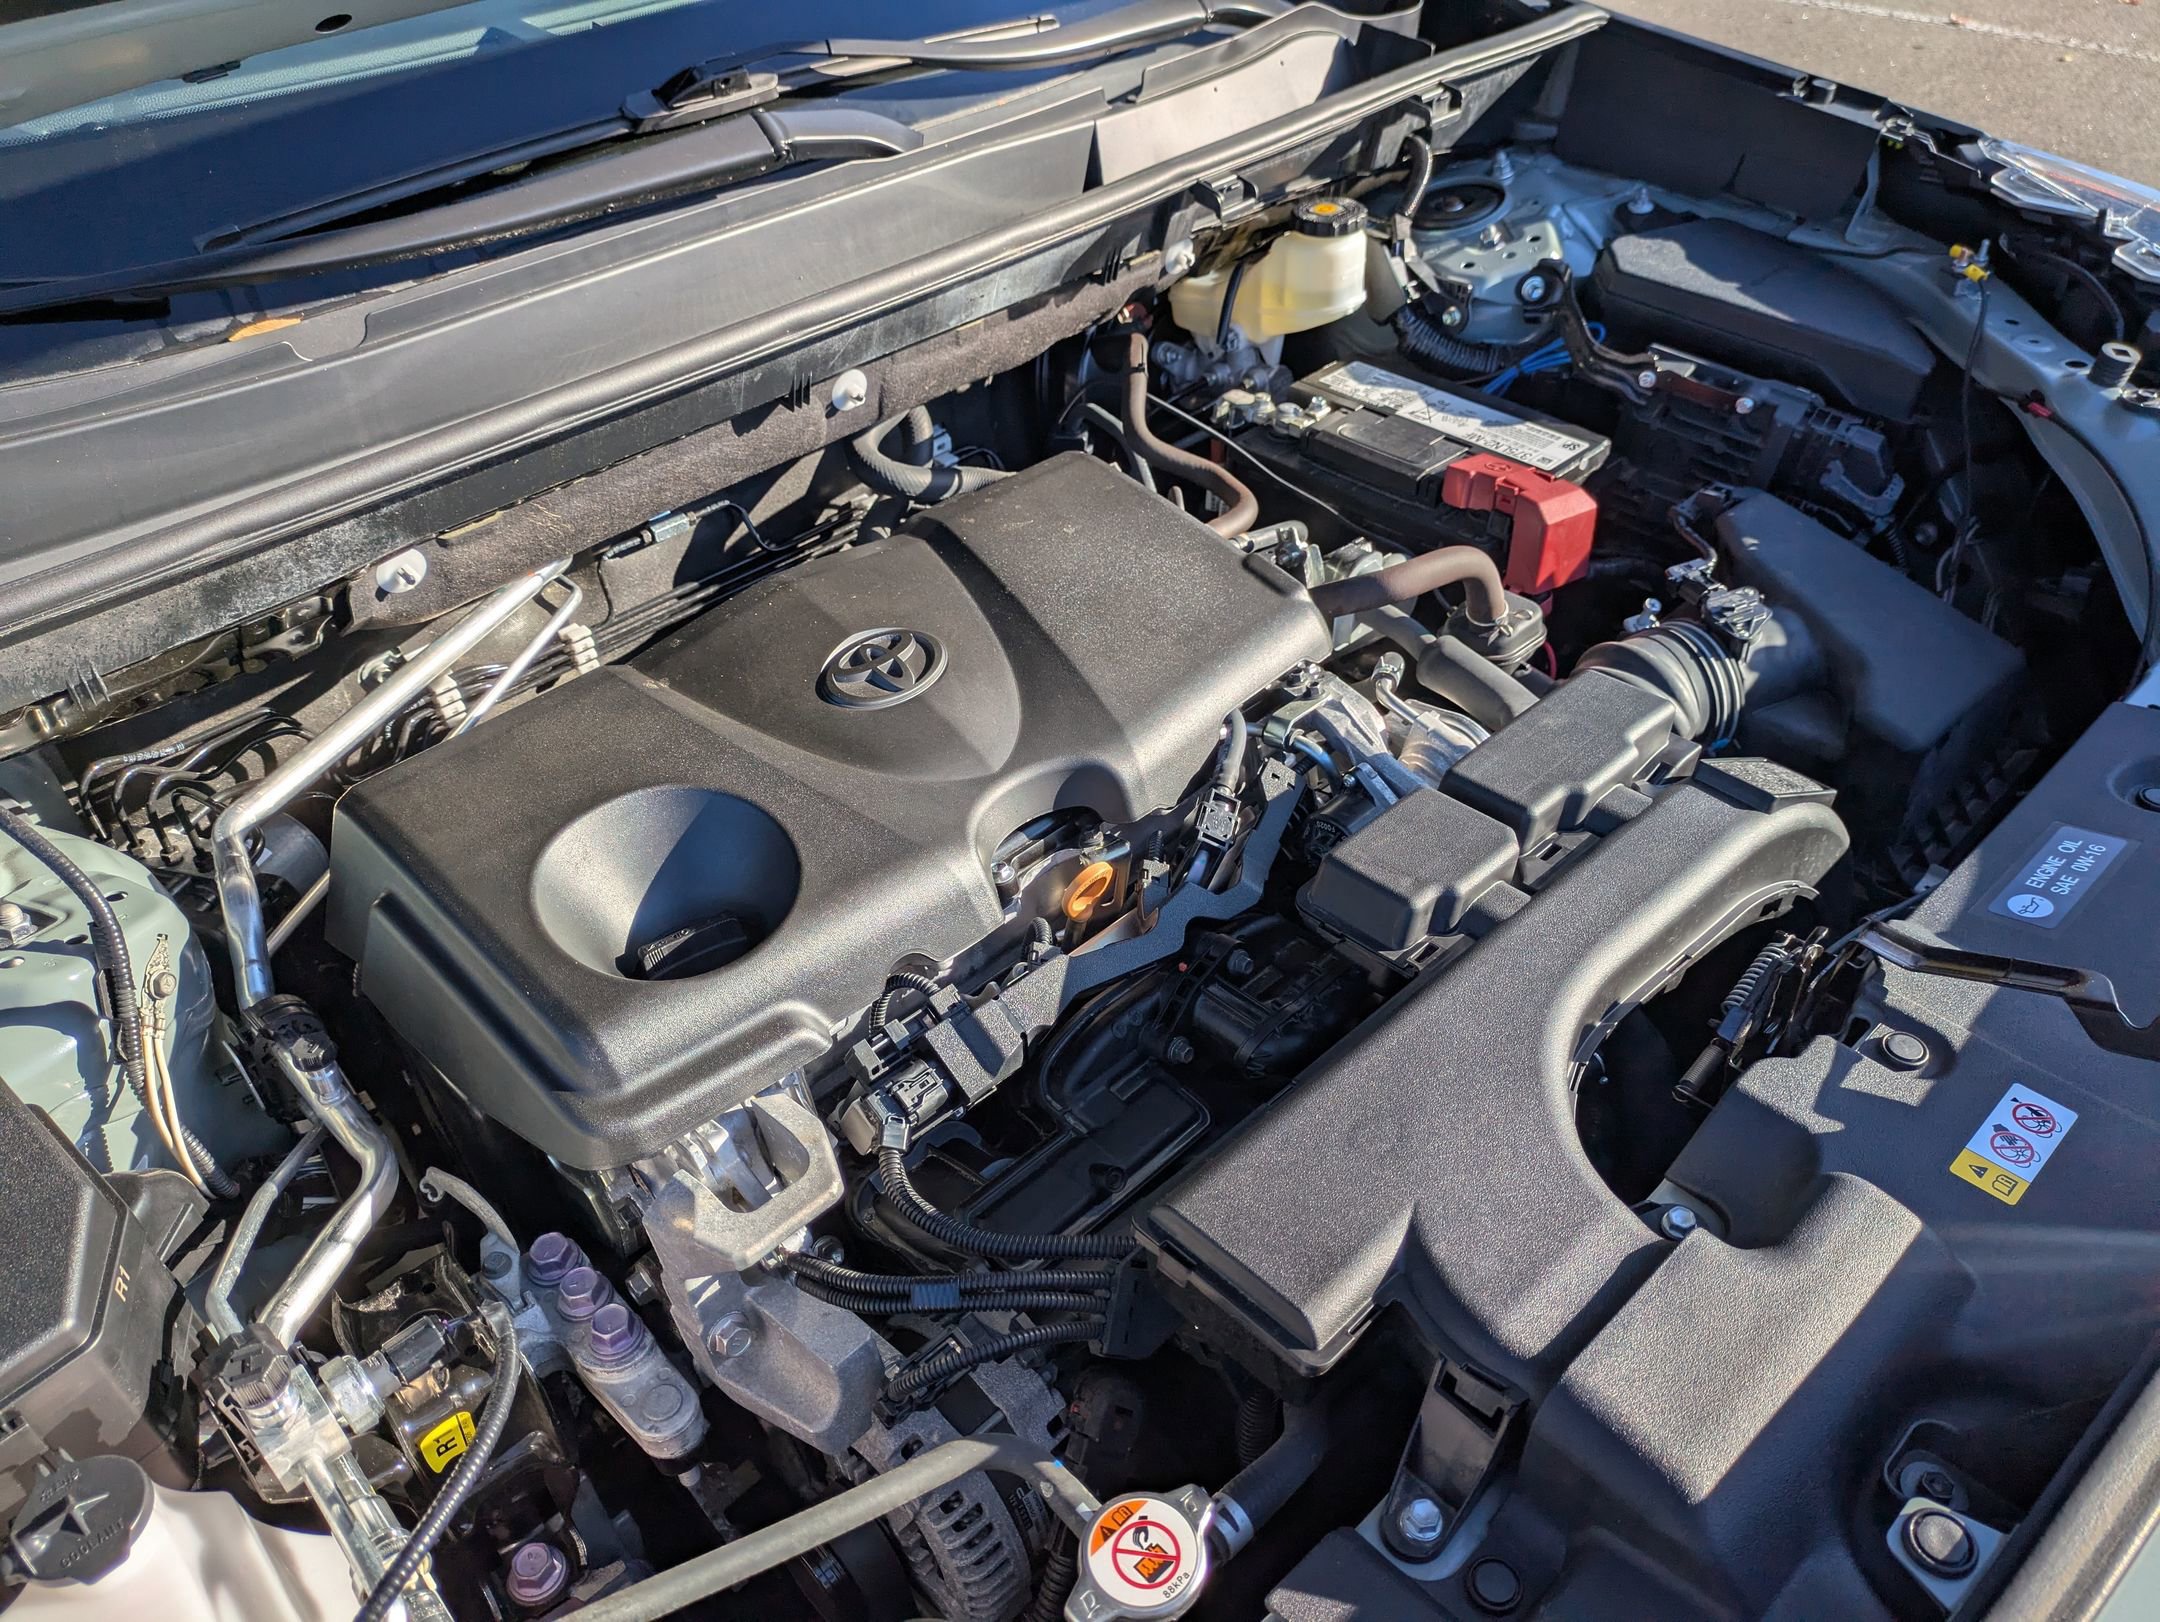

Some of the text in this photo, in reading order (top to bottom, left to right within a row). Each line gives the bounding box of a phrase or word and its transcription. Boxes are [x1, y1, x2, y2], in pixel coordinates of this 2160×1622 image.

[2025, 840, 2084, 889] ENGINE OIL
[2050, 844, 2107, 895] SAE 0W-16
[115, 1265, 130, 1302] R1
[432, 1428, 458, 1458] R1
[1162, 1572, 1190, 1599] 88kPa
